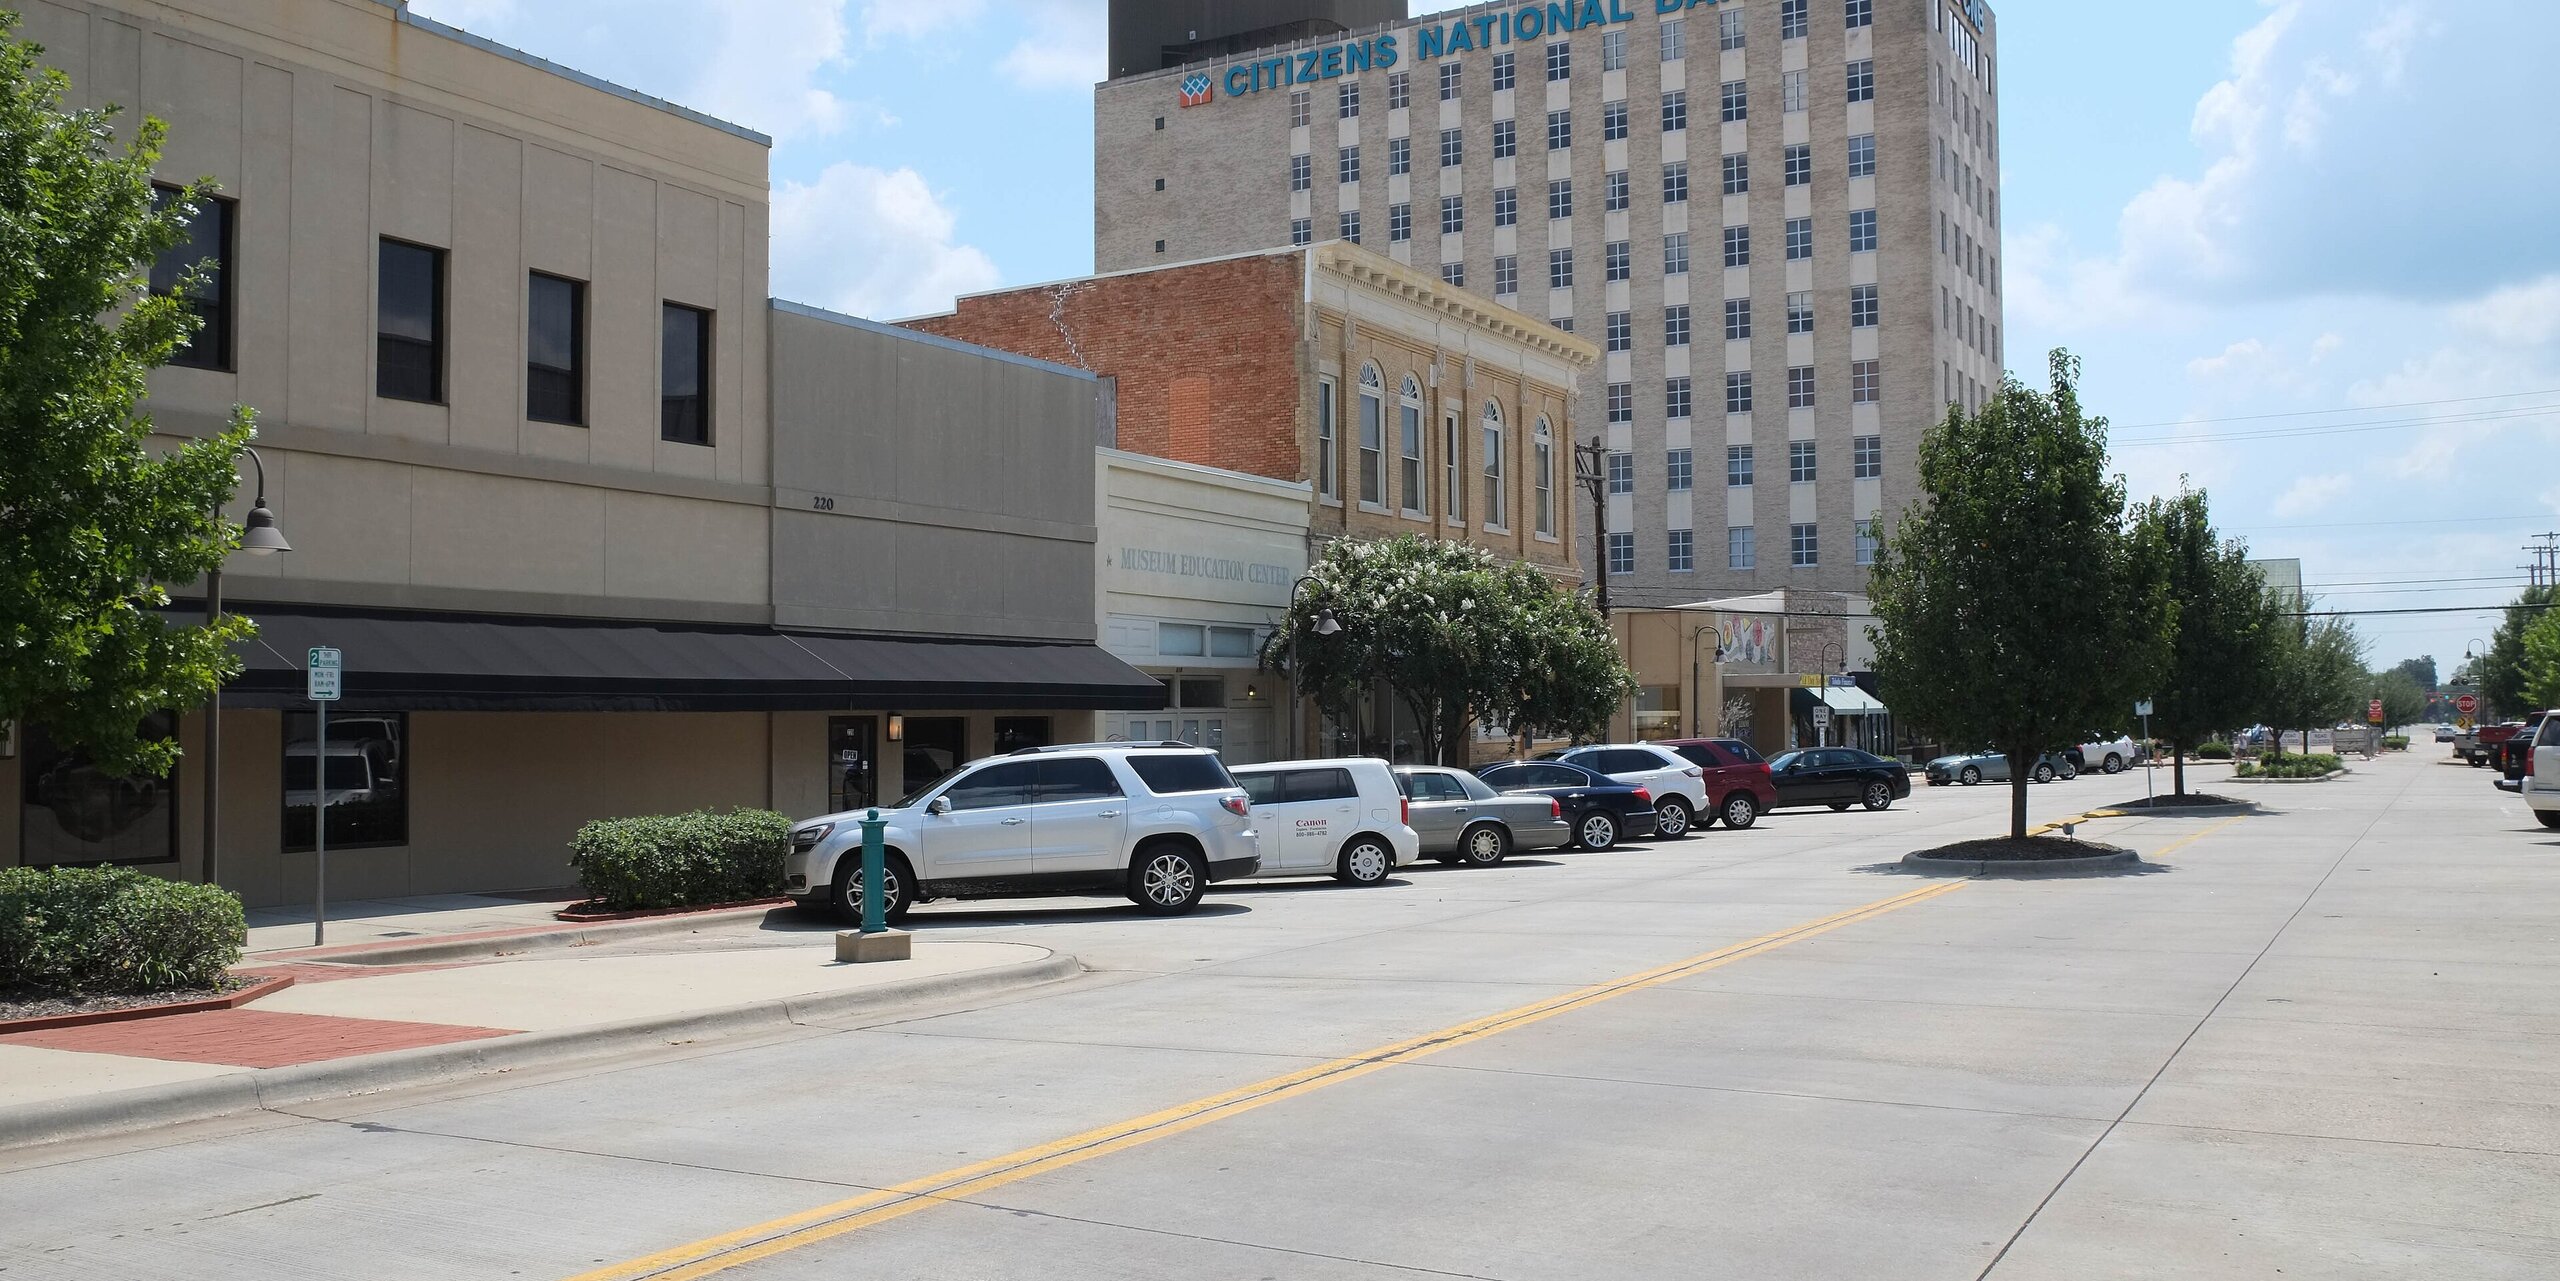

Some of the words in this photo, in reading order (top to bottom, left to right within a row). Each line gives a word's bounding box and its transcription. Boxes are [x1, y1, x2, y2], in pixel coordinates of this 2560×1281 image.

[1223, 35, 1398, 97] CITIZENS
[1417, 0, 1635, 61] NATIONAL
[813, 496, 834, 511] 220
[1120, 547, 1177, 575] MUSEUM
[1180, 554, 1244, 582] EDUCATION
[1248, 563, 1290, 586] CENTER
[311, 652, 318, 665] 2
[2458, 700, 2475, 708] STOP
[1295, 819, 1328, 828] Canon
